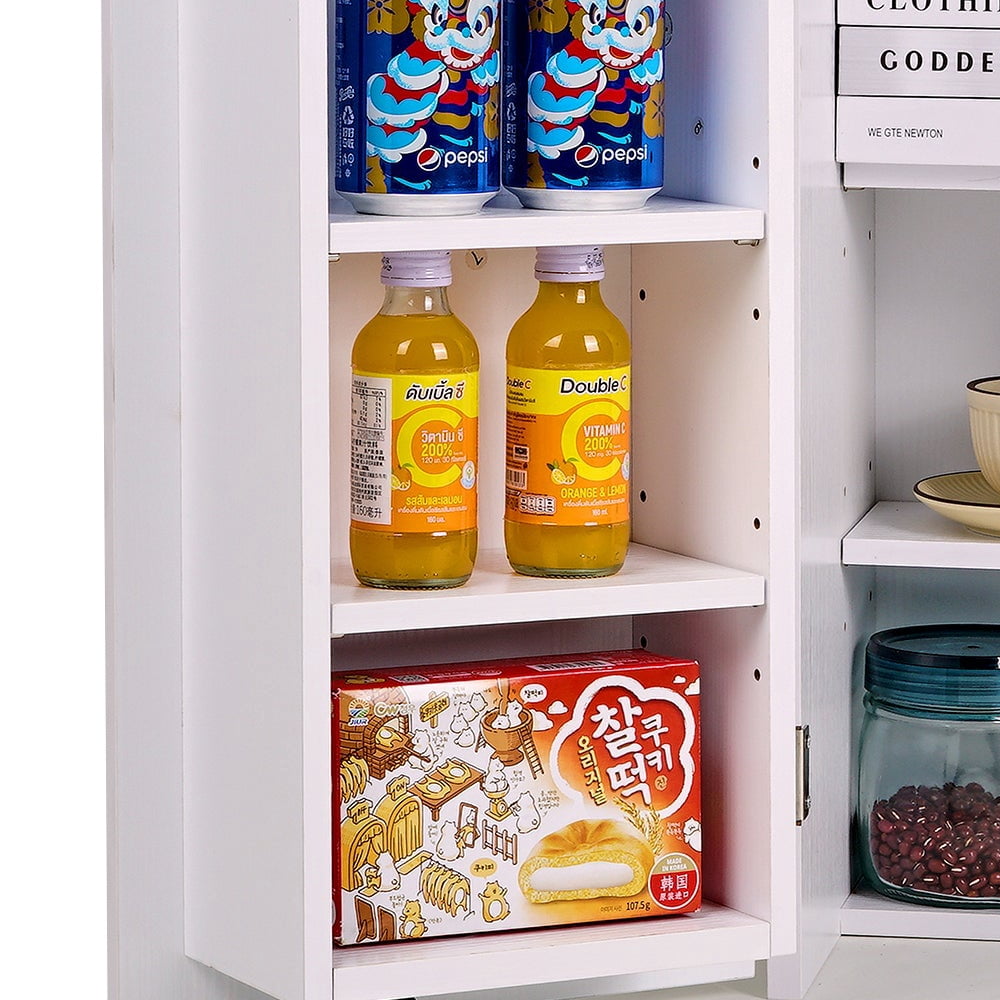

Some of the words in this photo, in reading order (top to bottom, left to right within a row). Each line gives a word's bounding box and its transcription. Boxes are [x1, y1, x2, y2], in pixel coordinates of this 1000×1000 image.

[867, 127, 882, 137] WE
[884, 127, 902, 138] GTE
[904, 128, 943, 139] NEWTON
[444, 146, 488, 168] pepsi
[601, 144, 648, 165] pepsi
[560, 377, 619, 393] Double
[620, 376, 627, 390] C
[583, 424, 620, 437] VITAMIN
[621, 422, 626, 434] C
[421, 443, 453, 457] 200%
[585, 437, 613, 451] 200%
[560, 487, 597, 498] ORANGE
[599, 486, 605, 497] &
[578, 736, 607, 806] 오리지널
[660, 874, 688, 891] 韩国
[626, 901, 651, 911] 107.5g
